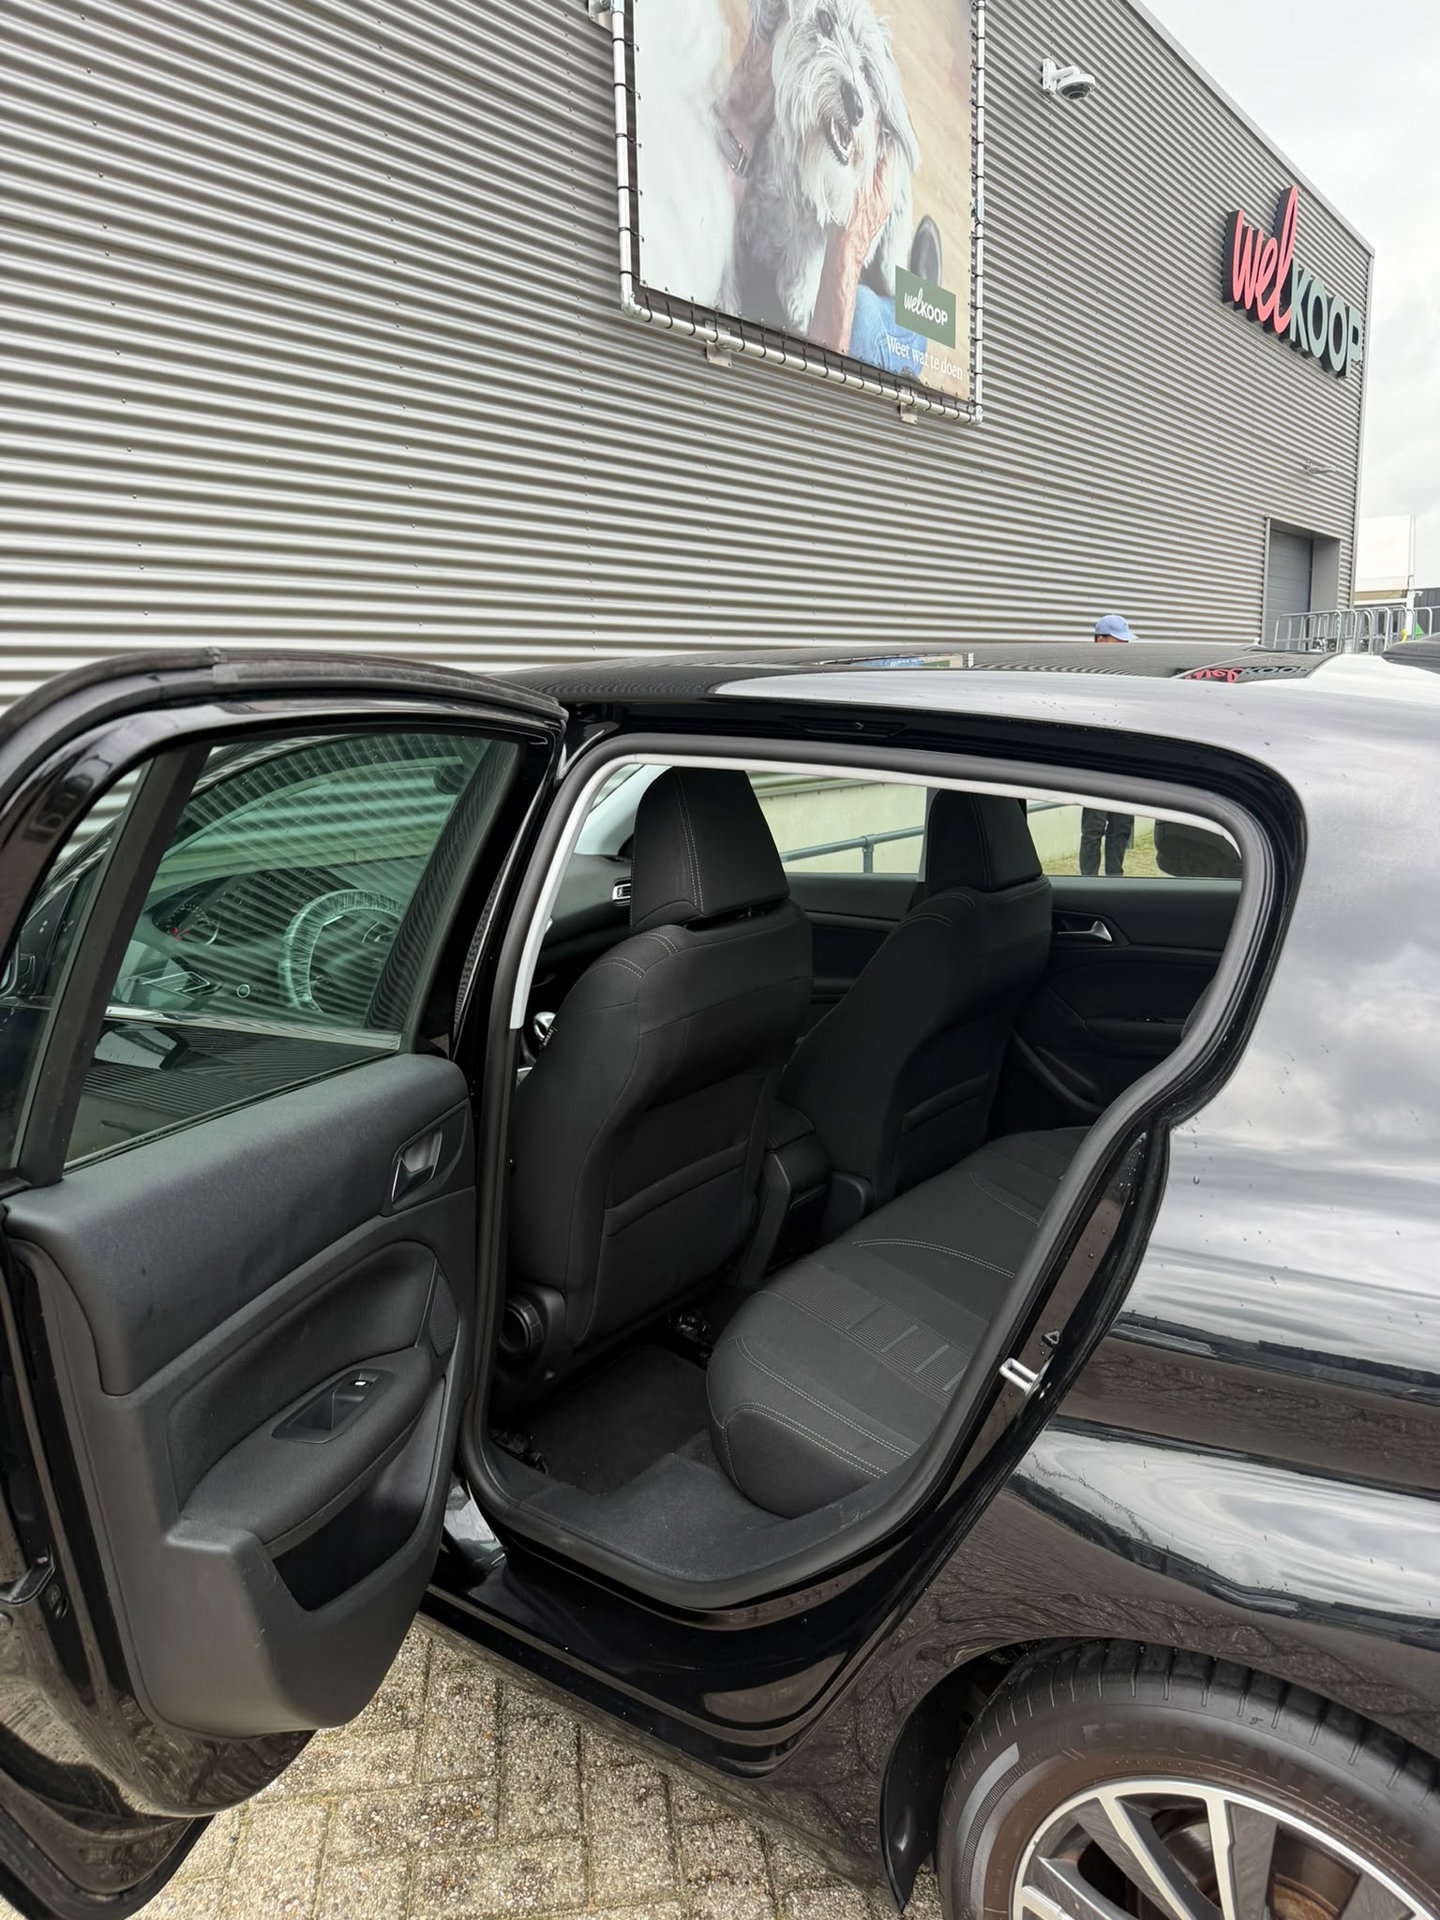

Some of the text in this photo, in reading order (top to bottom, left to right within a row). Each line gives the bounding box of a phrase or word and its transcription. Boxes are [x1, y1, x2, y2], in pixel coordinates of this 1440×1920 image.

[887, 335, 962, 380] Weet wat te doen
